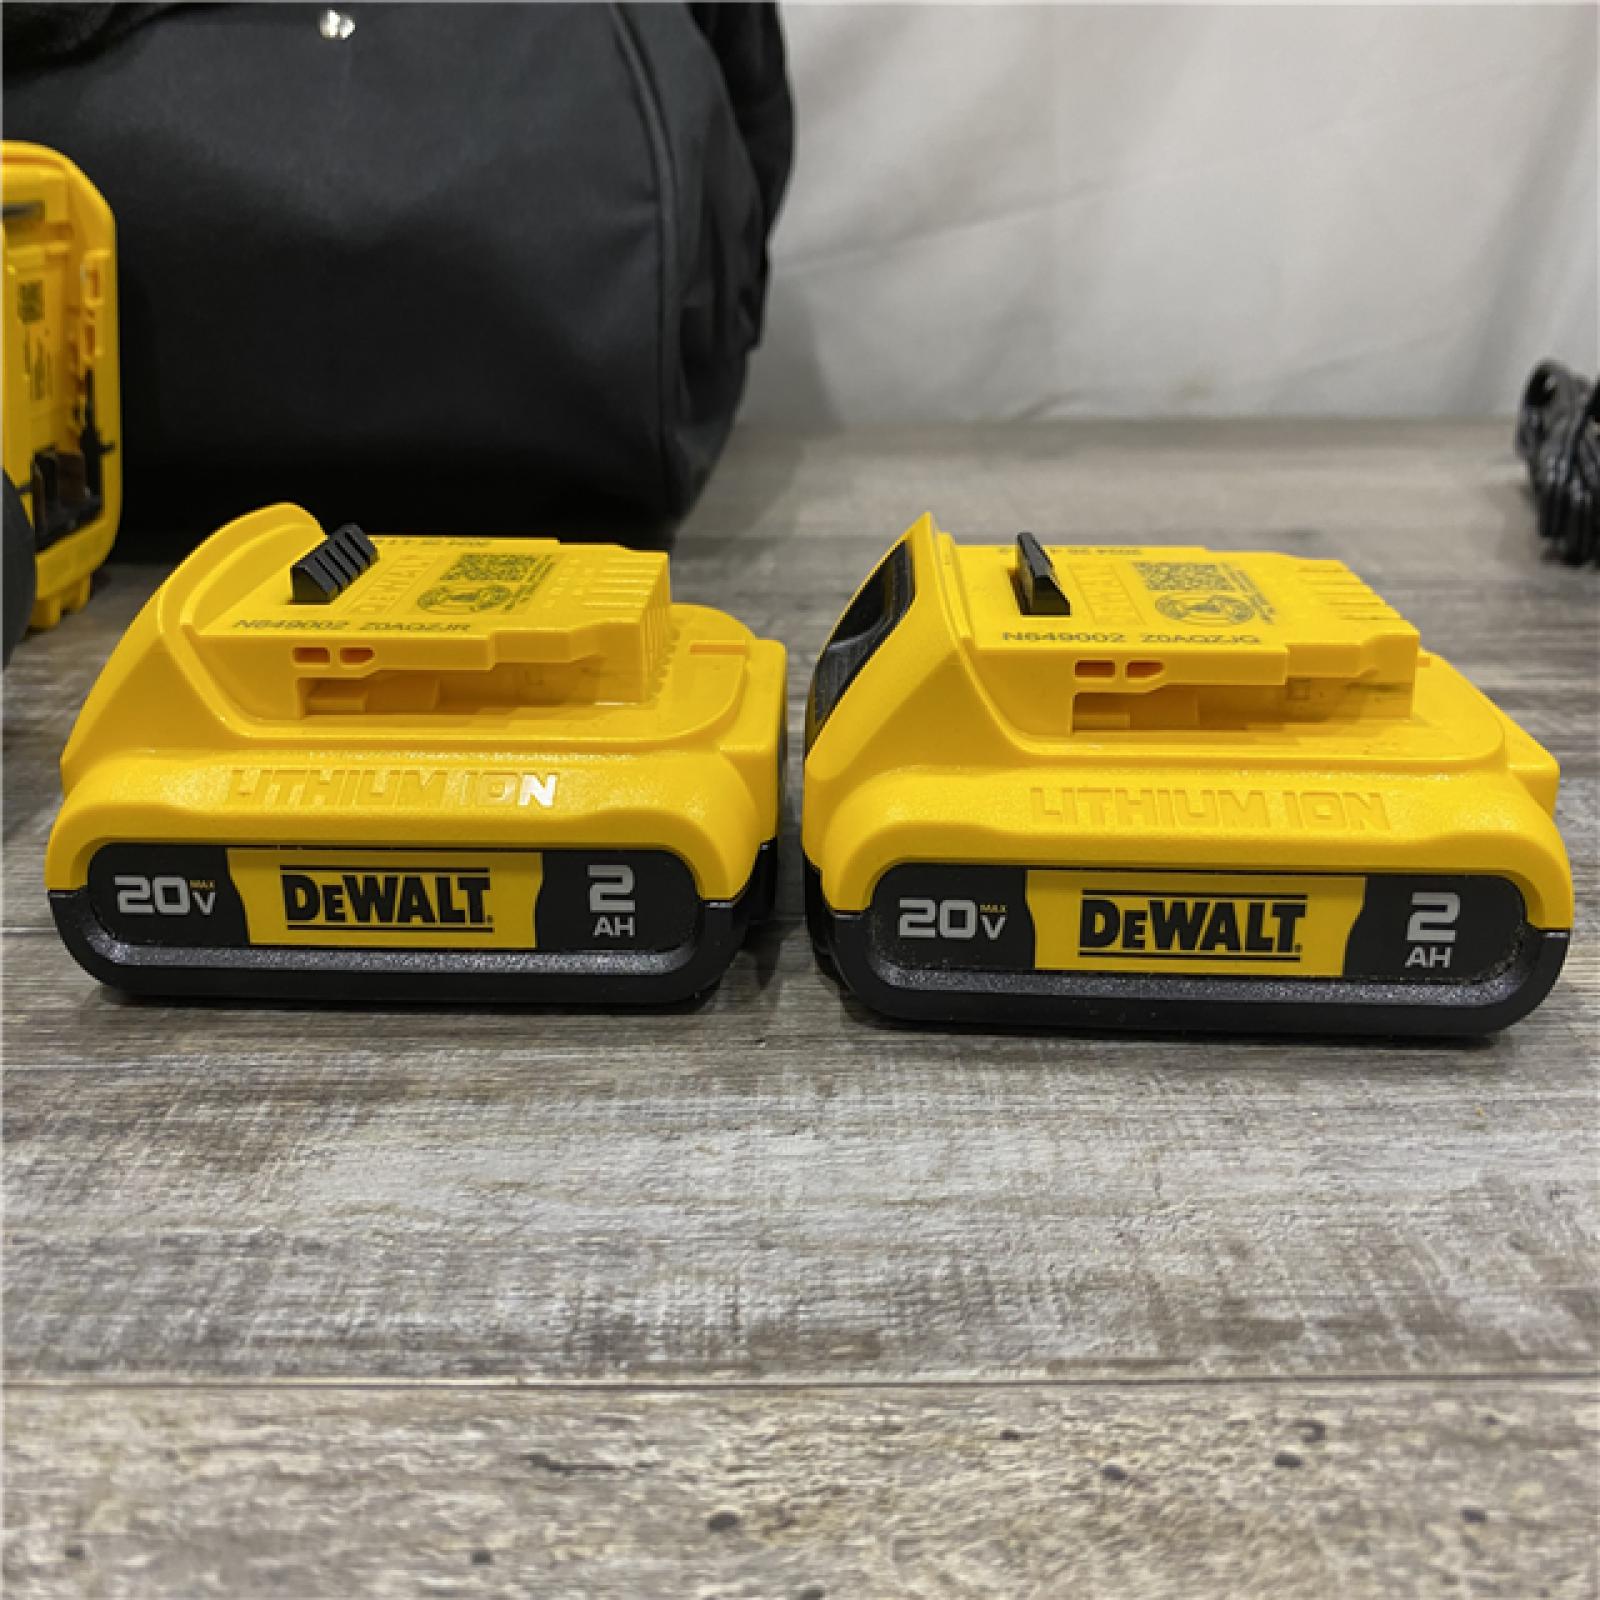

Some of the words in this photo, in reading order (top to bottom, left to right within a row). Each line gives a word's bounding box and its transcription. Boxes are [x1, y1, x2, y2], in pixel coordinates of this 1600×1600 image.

[227, 768, 449, 808] LITHIUM
[457, 770, 561, 808] ION
[1028, 786, 1272, 829] LITHIUM
[1281, 791, 1392, 832] ION
[587, 864, 636, 914] 2
[593, 916, 636, 938] AH
[1406, 891, 1461, 943] 2
[1404, 945, 1452, 969] AH
